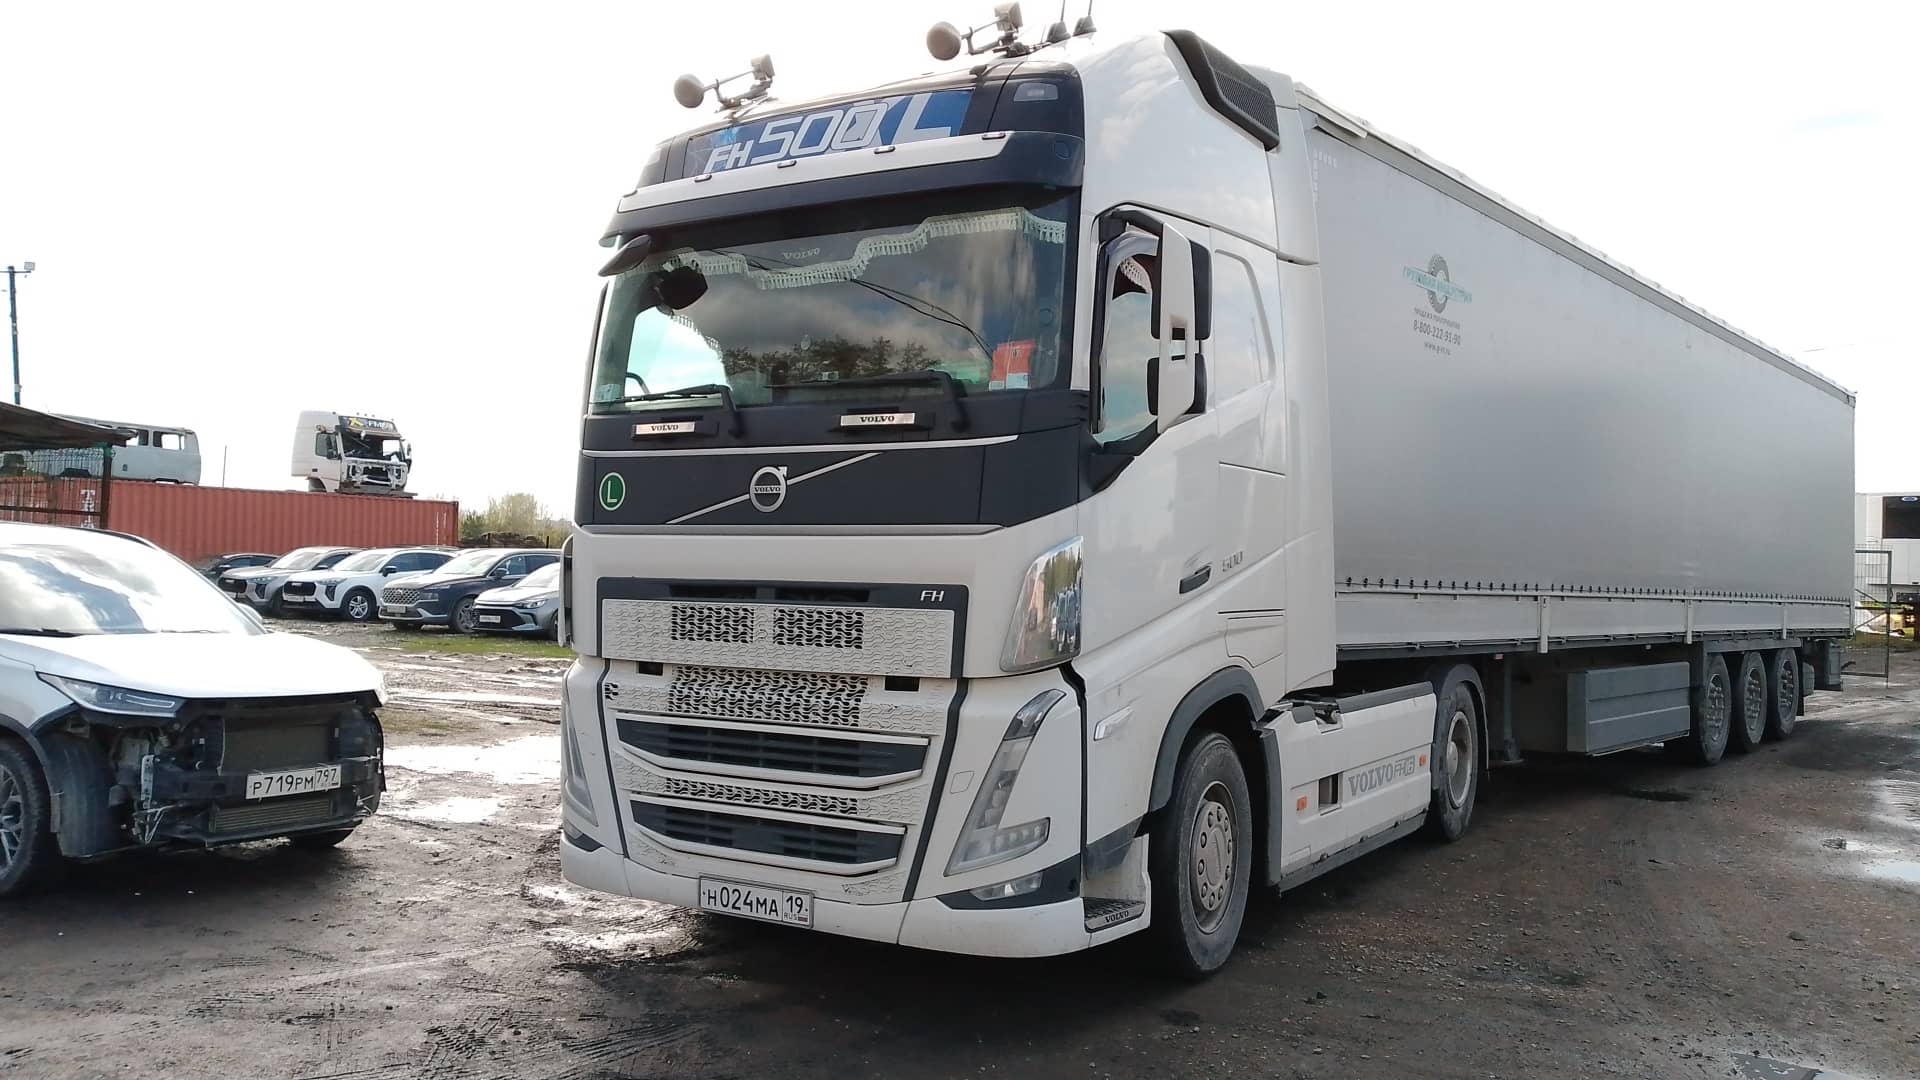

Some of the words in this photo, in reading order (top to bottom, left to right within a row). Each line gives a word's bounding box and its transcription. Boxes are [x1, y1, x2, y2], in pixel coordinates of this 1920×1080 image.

[703, 140, 754, 174] FH
[783, 247, 821, 260] VOLVO
[860, 415, 895, 423] VOLVO
[651, 424, 679, 432] VOLVO
[607, 480, 618, 503] L
[920, 590, 945, 602] FH
[1348, 763, 1393, 797] VOLVO
[785, 895, 804, 914] 19
[1105, 910, 1129, 923] VOLVO
